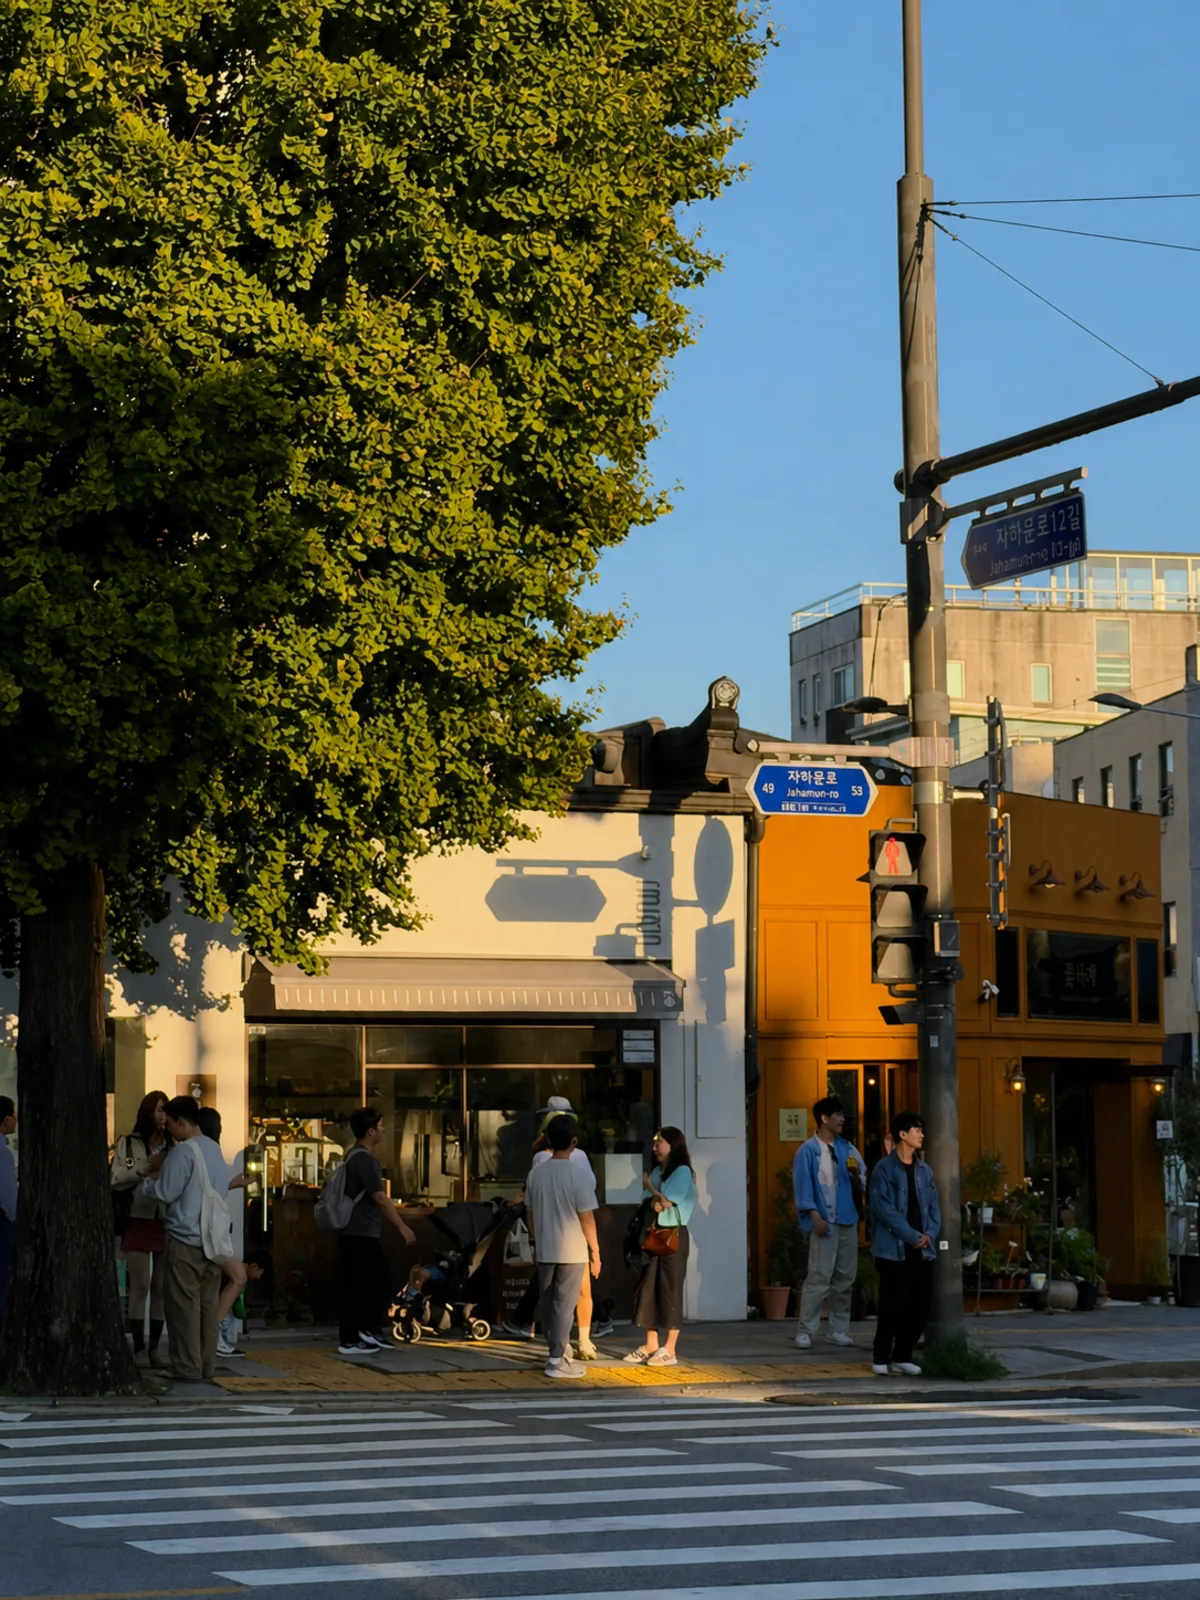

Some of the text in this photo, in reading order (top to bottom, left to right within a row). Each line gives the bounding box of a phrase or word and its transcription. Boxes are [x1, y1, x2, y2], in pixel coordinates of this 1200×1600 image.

[996, 503, 1081, 550] 자하문로12길
[788, 770, 838, 786] 자하문로
[762, 783, 775, 794] 49
[786, 788, 840, 799] Jahamun-ro
[851, 785, 863, 797] 53
